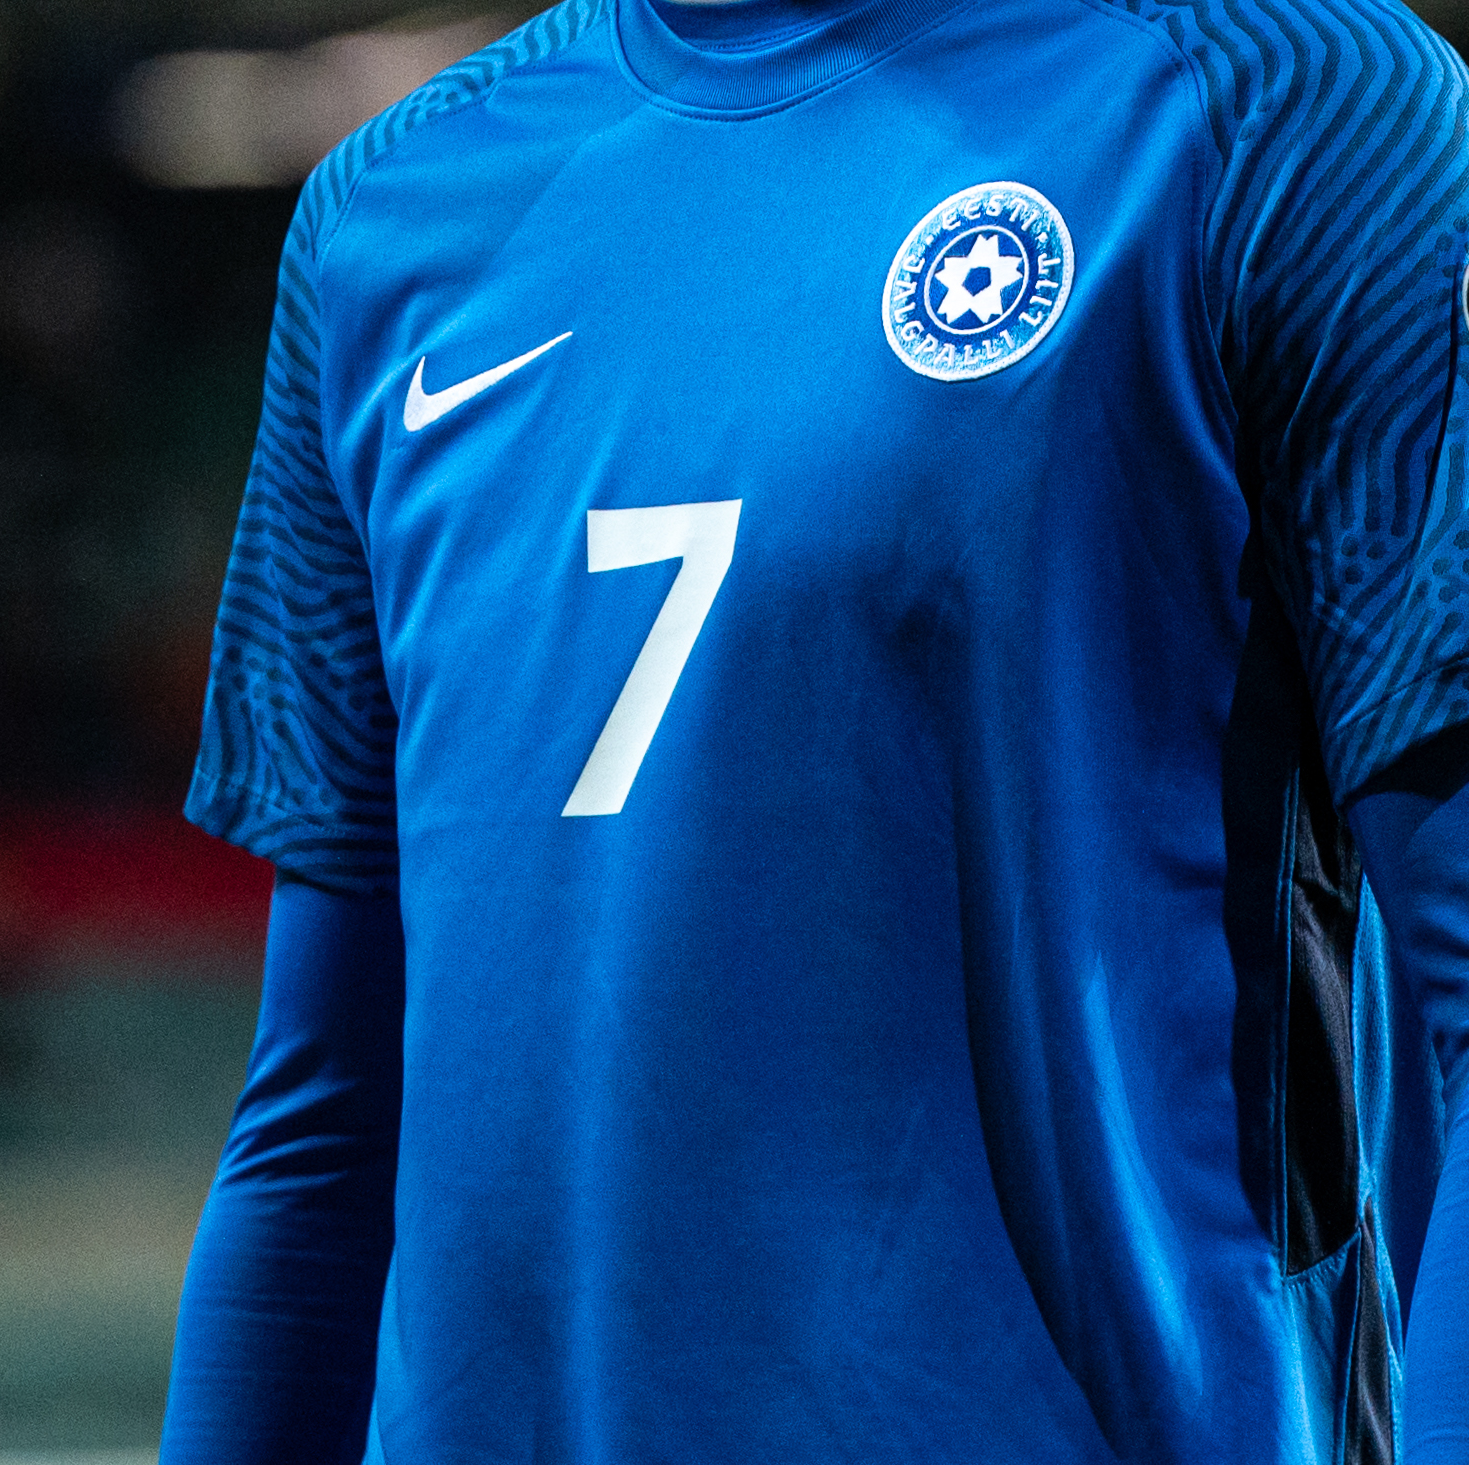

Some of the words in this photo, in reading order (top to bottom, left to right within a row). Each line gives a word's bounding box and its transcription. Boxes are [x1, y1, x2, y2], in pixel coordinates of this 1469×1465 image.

[941, 194, 1040, 232] EESTI
[893, 253, 1015, 366] JALGPALLI
[1018, 253, 1062, 327] LIIT
[560, 498, 743, 818] 7
